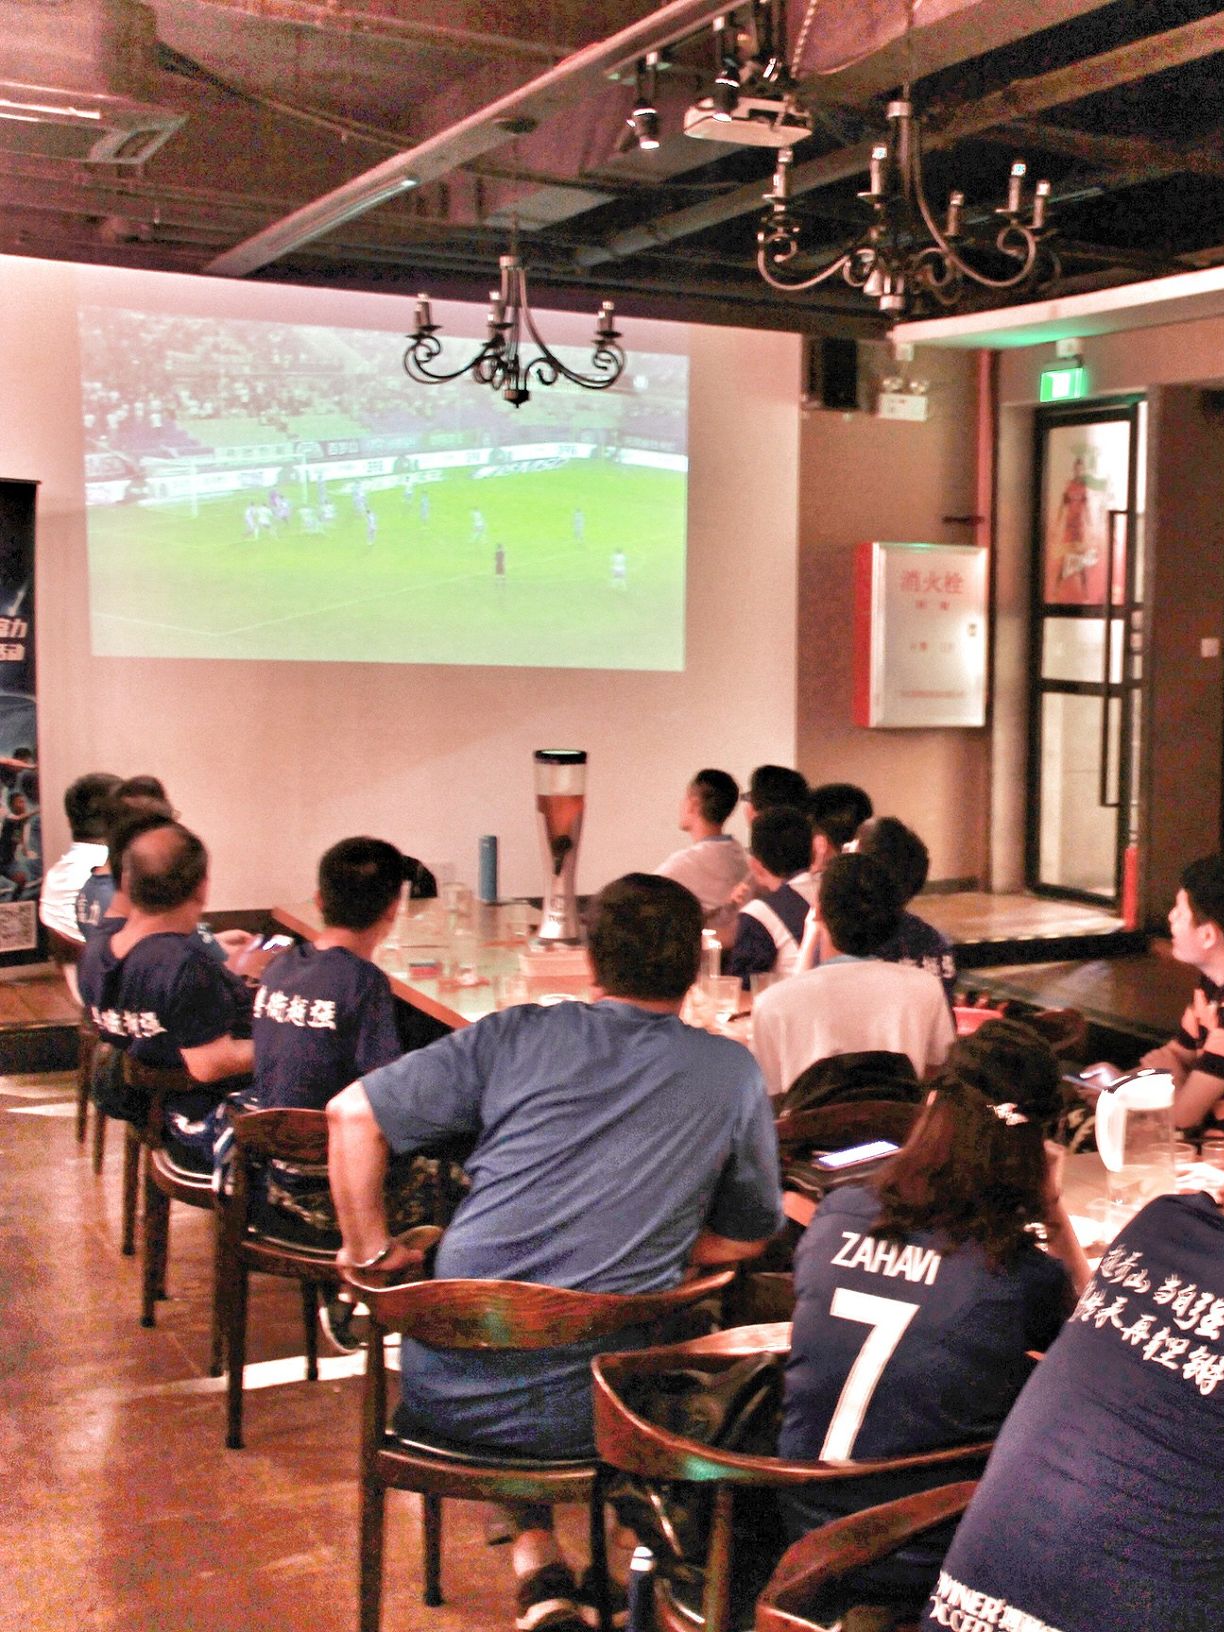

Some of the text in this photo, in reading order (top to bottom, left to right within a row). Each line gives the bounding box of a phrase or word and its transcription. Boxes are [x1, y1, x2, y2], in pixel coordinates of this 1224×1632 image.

[901, 570, 964, 594] 消火栓
[830, 1231, 942, 1286] ZAHAVI
[818, 1287, 921, 1462] 7
